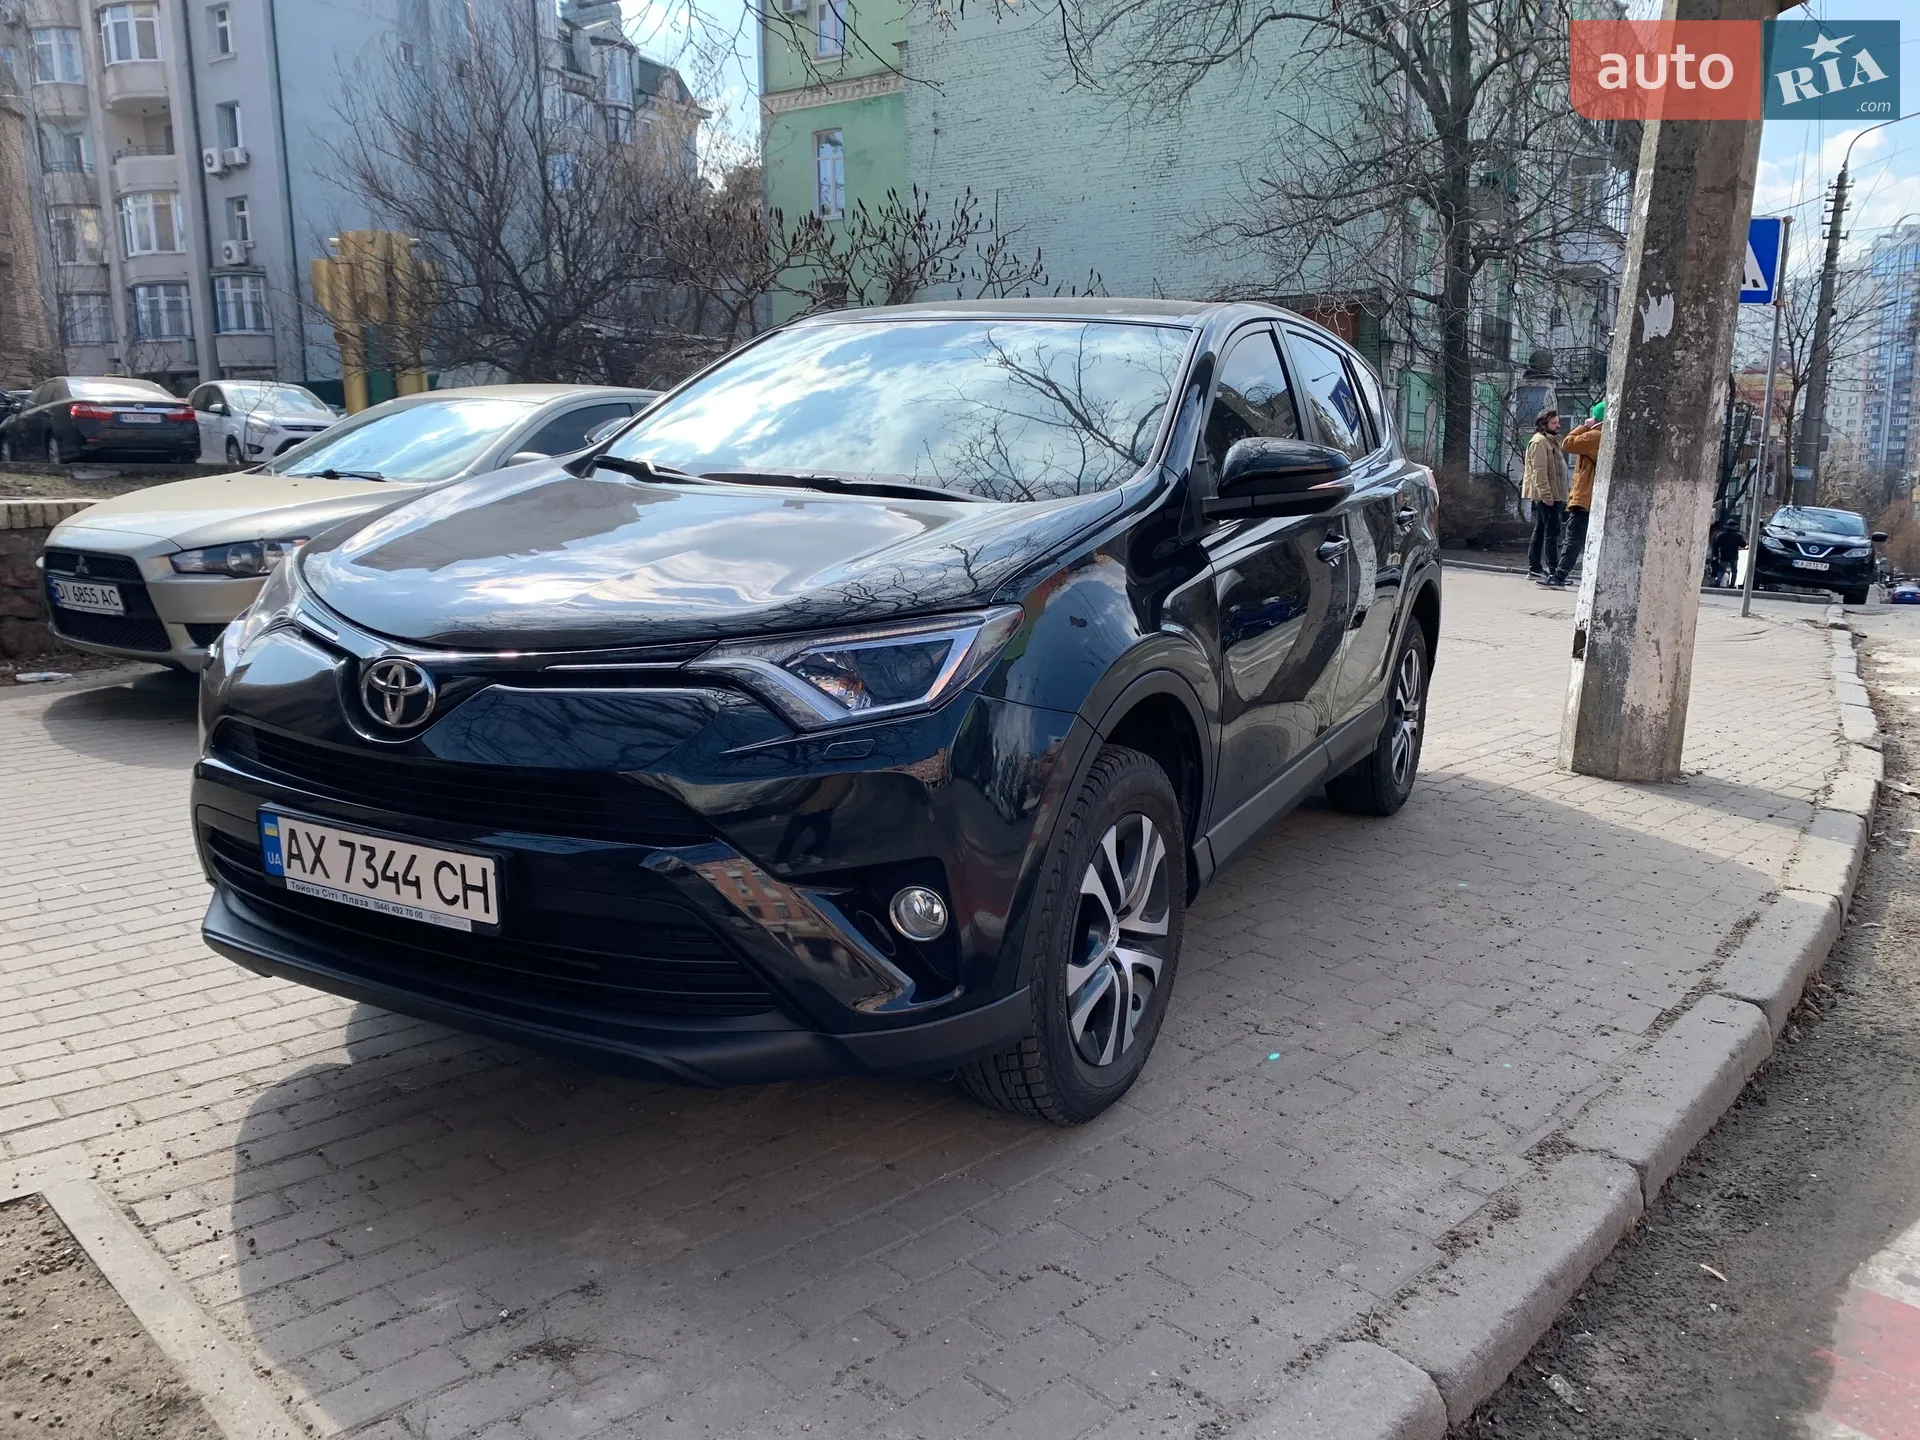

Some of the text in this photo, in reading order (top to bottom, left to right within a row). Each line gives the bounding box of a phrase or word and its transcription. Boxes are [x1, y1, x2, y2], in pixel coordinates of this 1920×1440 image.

[54, 582, 119, 606] DI 6855 AC
[267, 851, 282, 866] UA
[287, 828, 490, 914] AX 7344 CH
[322, 889, 338, 900] Сіті
[342, 893, 369, 907] Плаза
[373, 900, 390, 913] (044)
[391, 905, 404, 915] 492
[405, 908, 414, 917] 70
[414, 911, 424, 919] 00
